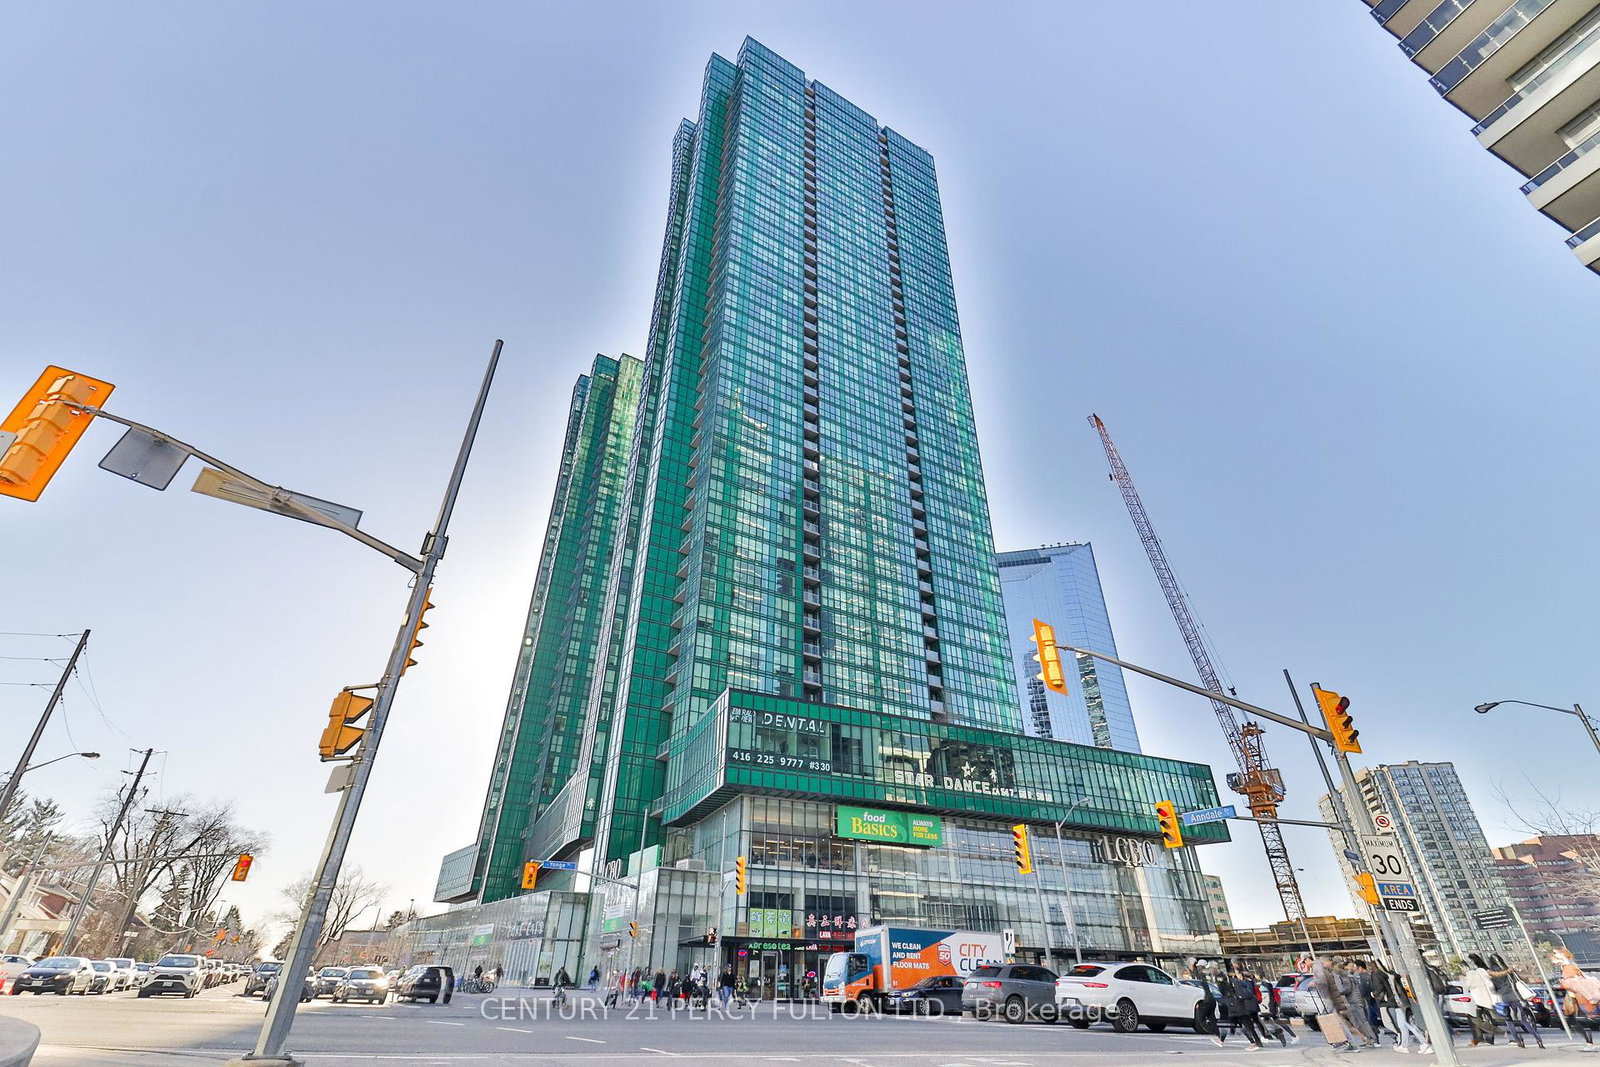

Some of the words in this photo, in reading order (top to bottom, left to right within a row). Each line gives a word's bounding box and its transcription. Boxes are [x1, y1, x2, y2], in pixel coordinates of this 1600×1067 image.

[761, 713, 825, 733] DENTAL
[732, 751, 751, 761] 416
[757, 754, 775, 764] 225
[780, 757, 804, 768] 9777
[809, 761, 831, 772] #330
[894, 770, 934, 788] STAR
[863, 811, 886, 823] food
[1190, 810, 1223, 822] Anndale
[851, 816, 898, 838] Basics
[912, 819, 934, 827] ALWAYS
[1364, 839, 1395, 848] MAXIMUM
[1101, 835, 1156, 866] LCBO
[1372, 854, 1402, 875] 30
[1383, 884, 1411, 895] AREA
[1388, 899, 1414, 910] ENDS
[902, 942, 921, 950] CLEAN
[959, 943, 987, 957] CITY
[939, 952, 951, 961] 50
[893, 961, 913, 969] FLOOR
[913, 962, 930, 970] MATS
